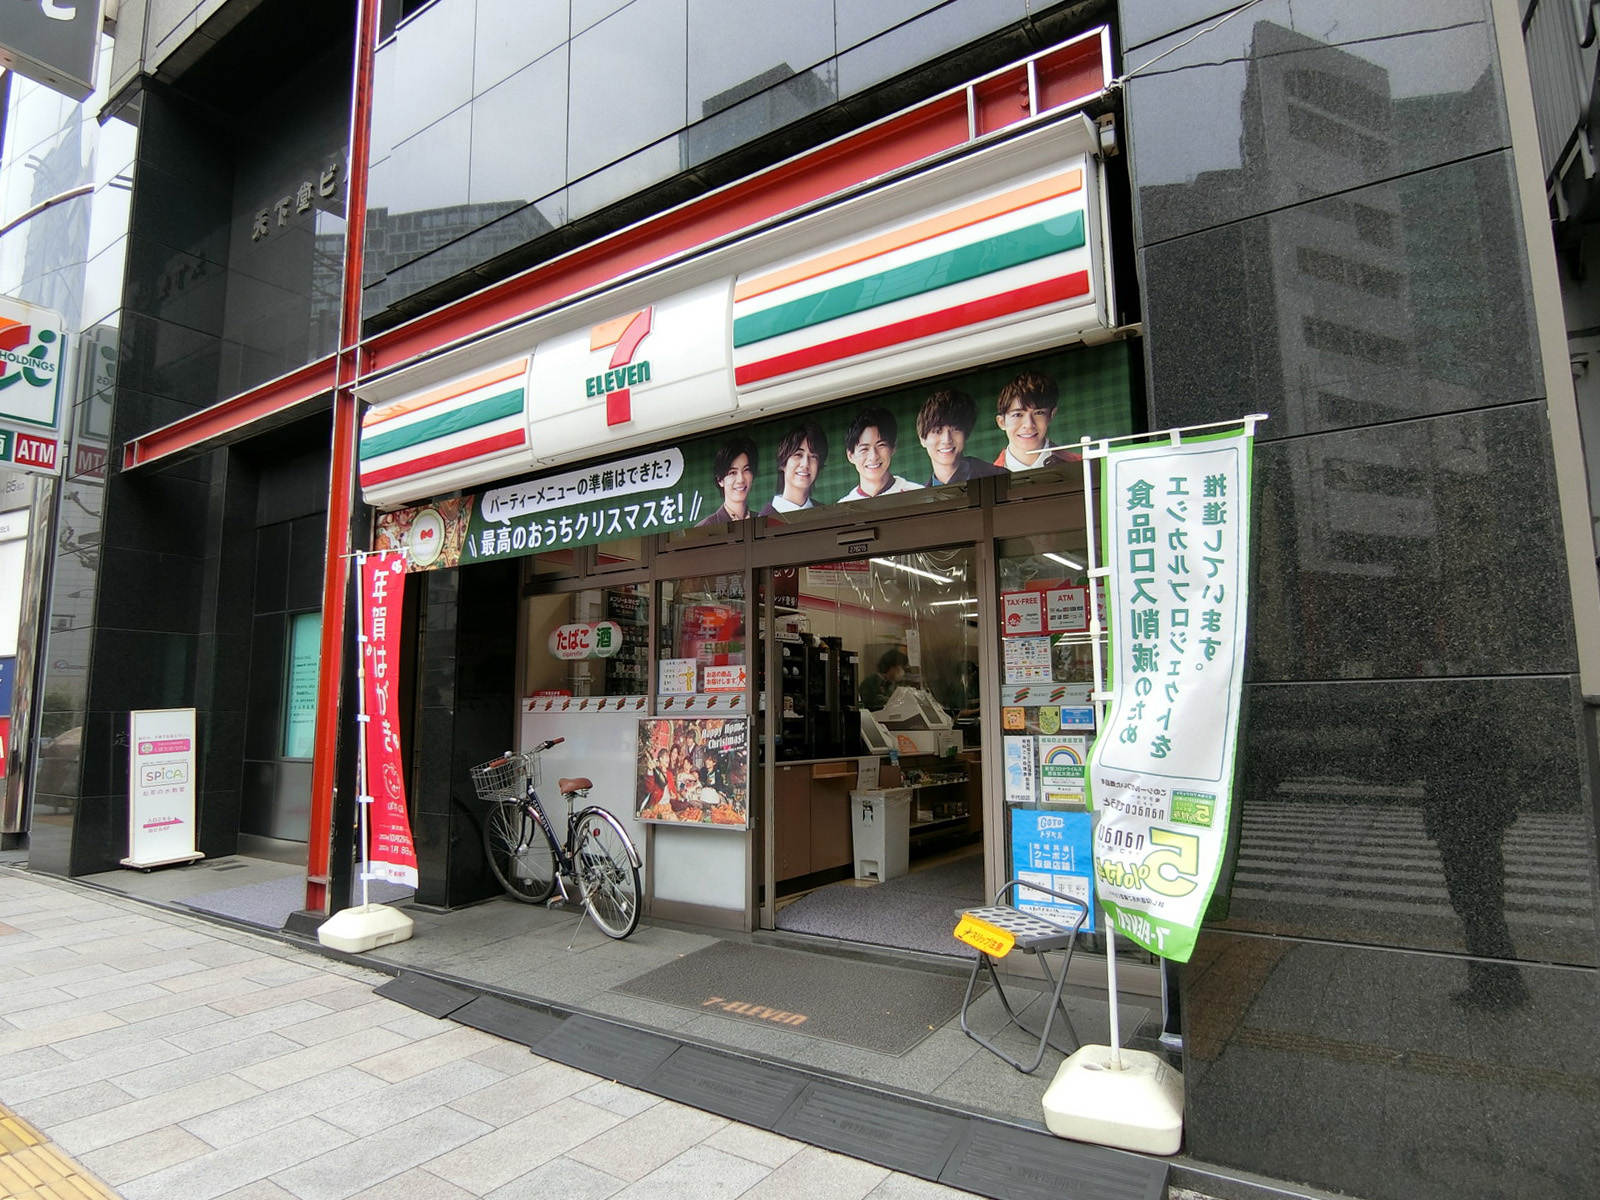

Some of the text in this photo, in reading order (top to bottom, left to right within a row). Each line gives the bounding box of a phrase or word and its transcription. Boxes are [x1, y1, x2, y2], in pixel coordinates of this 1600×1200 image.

[251, 162, 346, 241] 天下堂ビ
[0, 351, 55, 372] HOLDINGS
[17, 438, 55, 465] ATM
[1057, 594, 1075, 602] ATM
[556, 628, 590, 651] たばこ
[596, 626, 612, 648] 酒
[372, 569, 393, 753] 年賀はがき
[562, 650, 583, 658] cigarette
[1040, 831, 1063, 840] トラベル
[1034, 850, 1070, 861] クーポン
